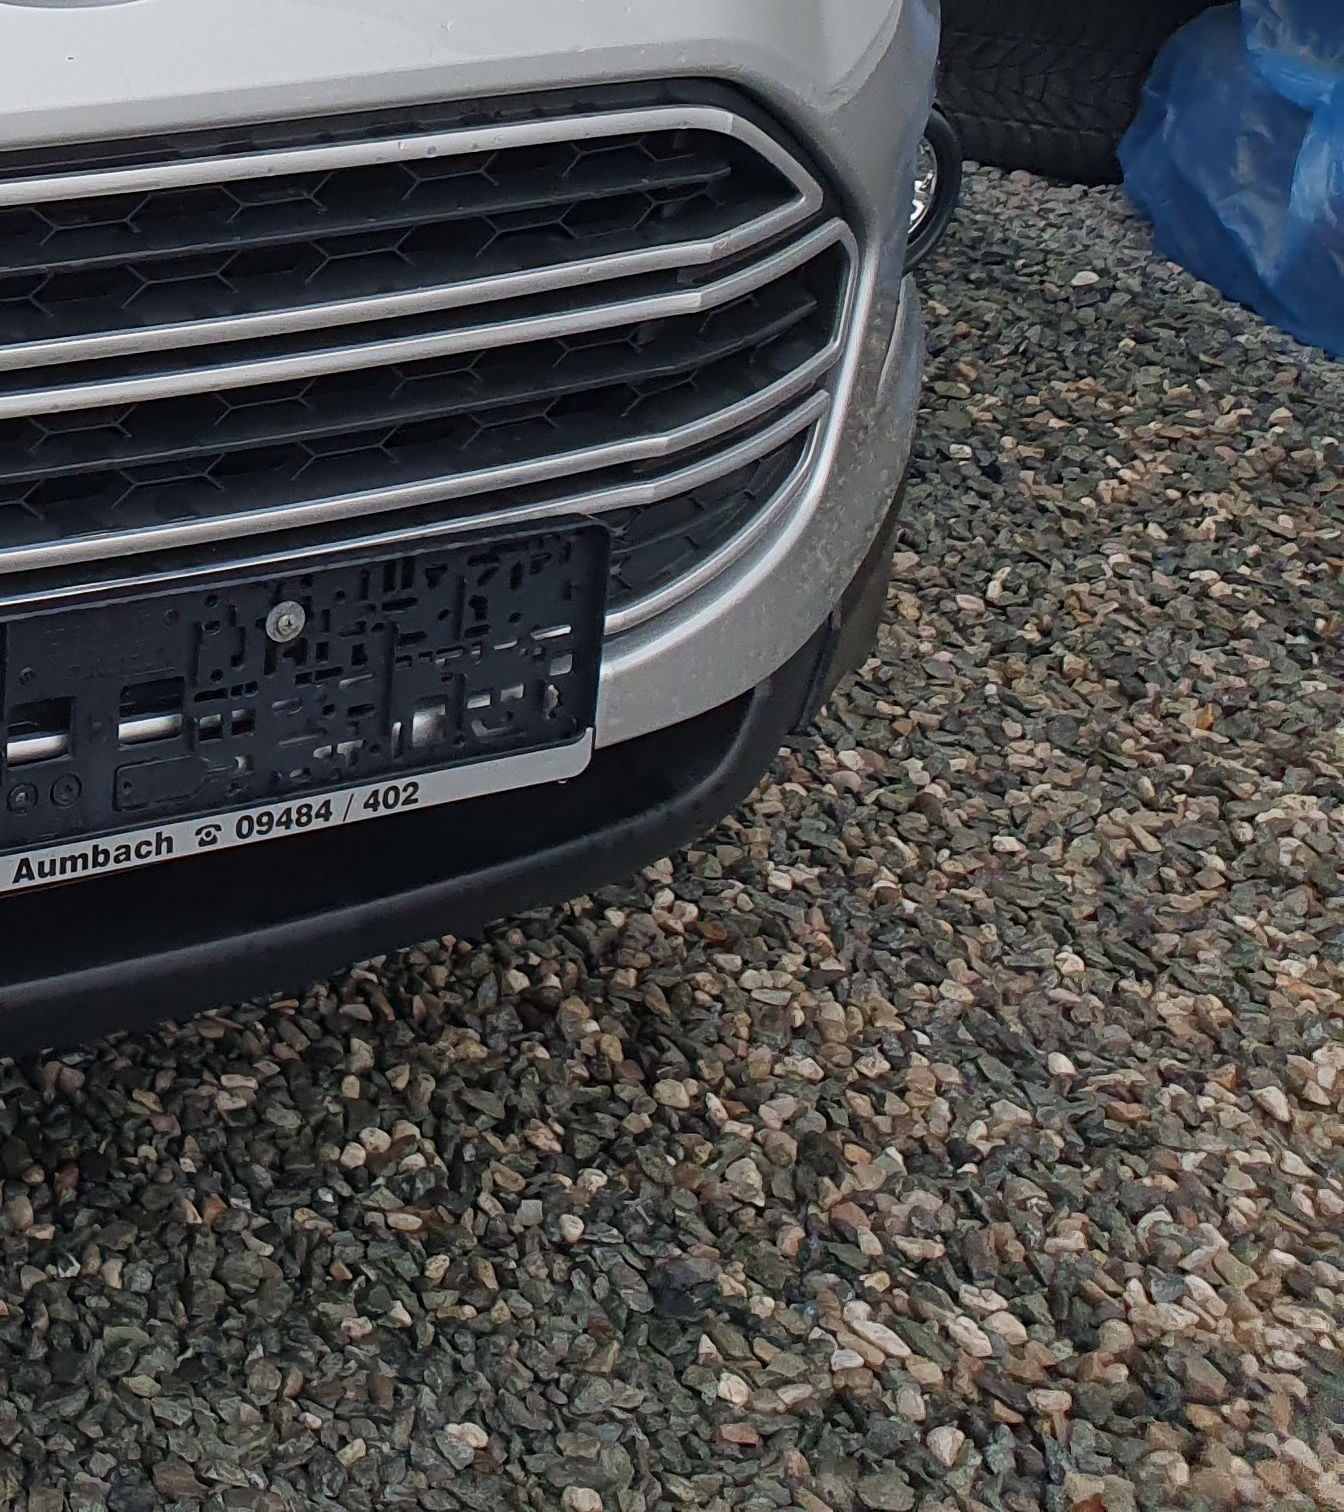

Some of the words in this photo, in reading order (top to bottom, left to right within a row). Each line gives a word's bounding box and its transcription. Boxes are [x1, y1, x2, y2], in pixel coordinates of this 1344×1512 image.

[11, 831, 174, 884] Aumbach
[235, 798, 333, 840] 09484
[342, 792, 354, 823] /
[362, 780, 420, 813] 402
